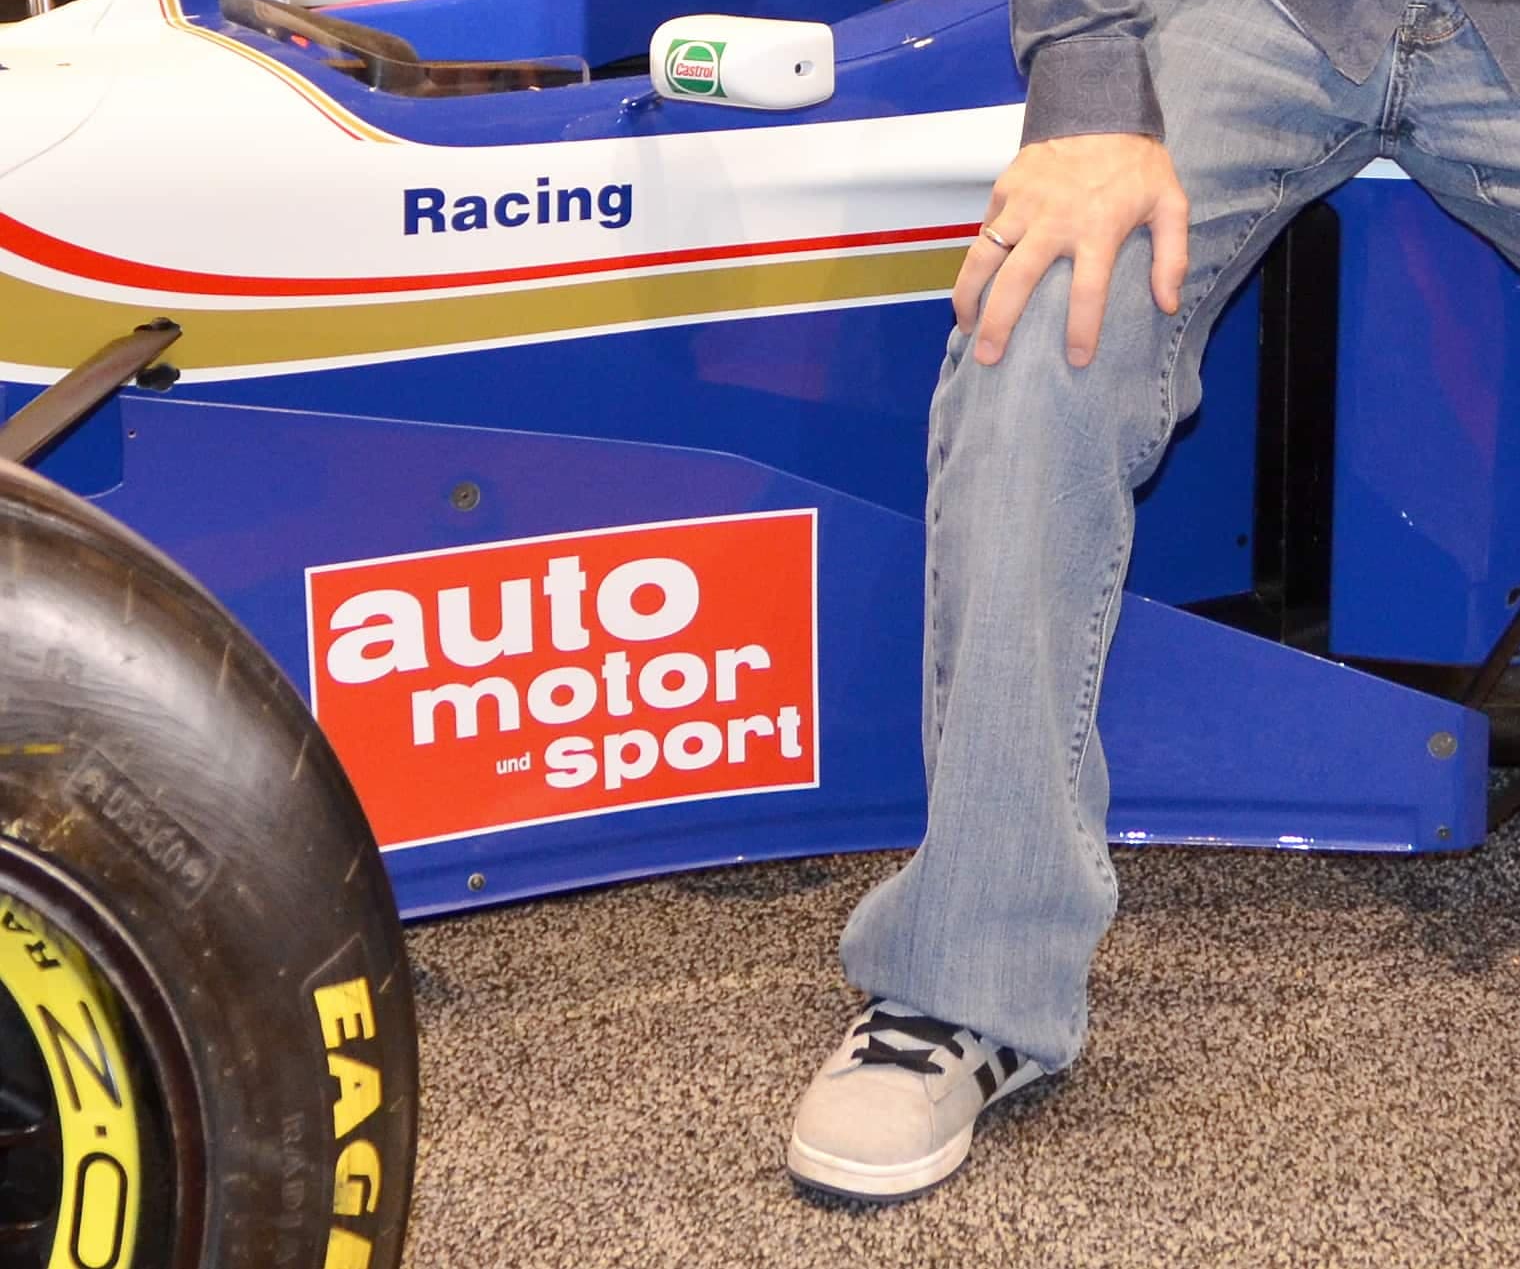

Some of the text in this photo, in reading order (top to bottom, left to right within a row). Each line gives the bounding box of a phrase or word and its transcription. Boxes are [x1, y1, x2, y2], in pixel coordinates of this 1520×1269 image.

[675, 62, 715, 79] Castrol
[402, 176, 634, 236] Racing
[326, 554, 701, 685] auto
[410, 643, 772, 746] motor
[495, 705, 803, 791] und sport
